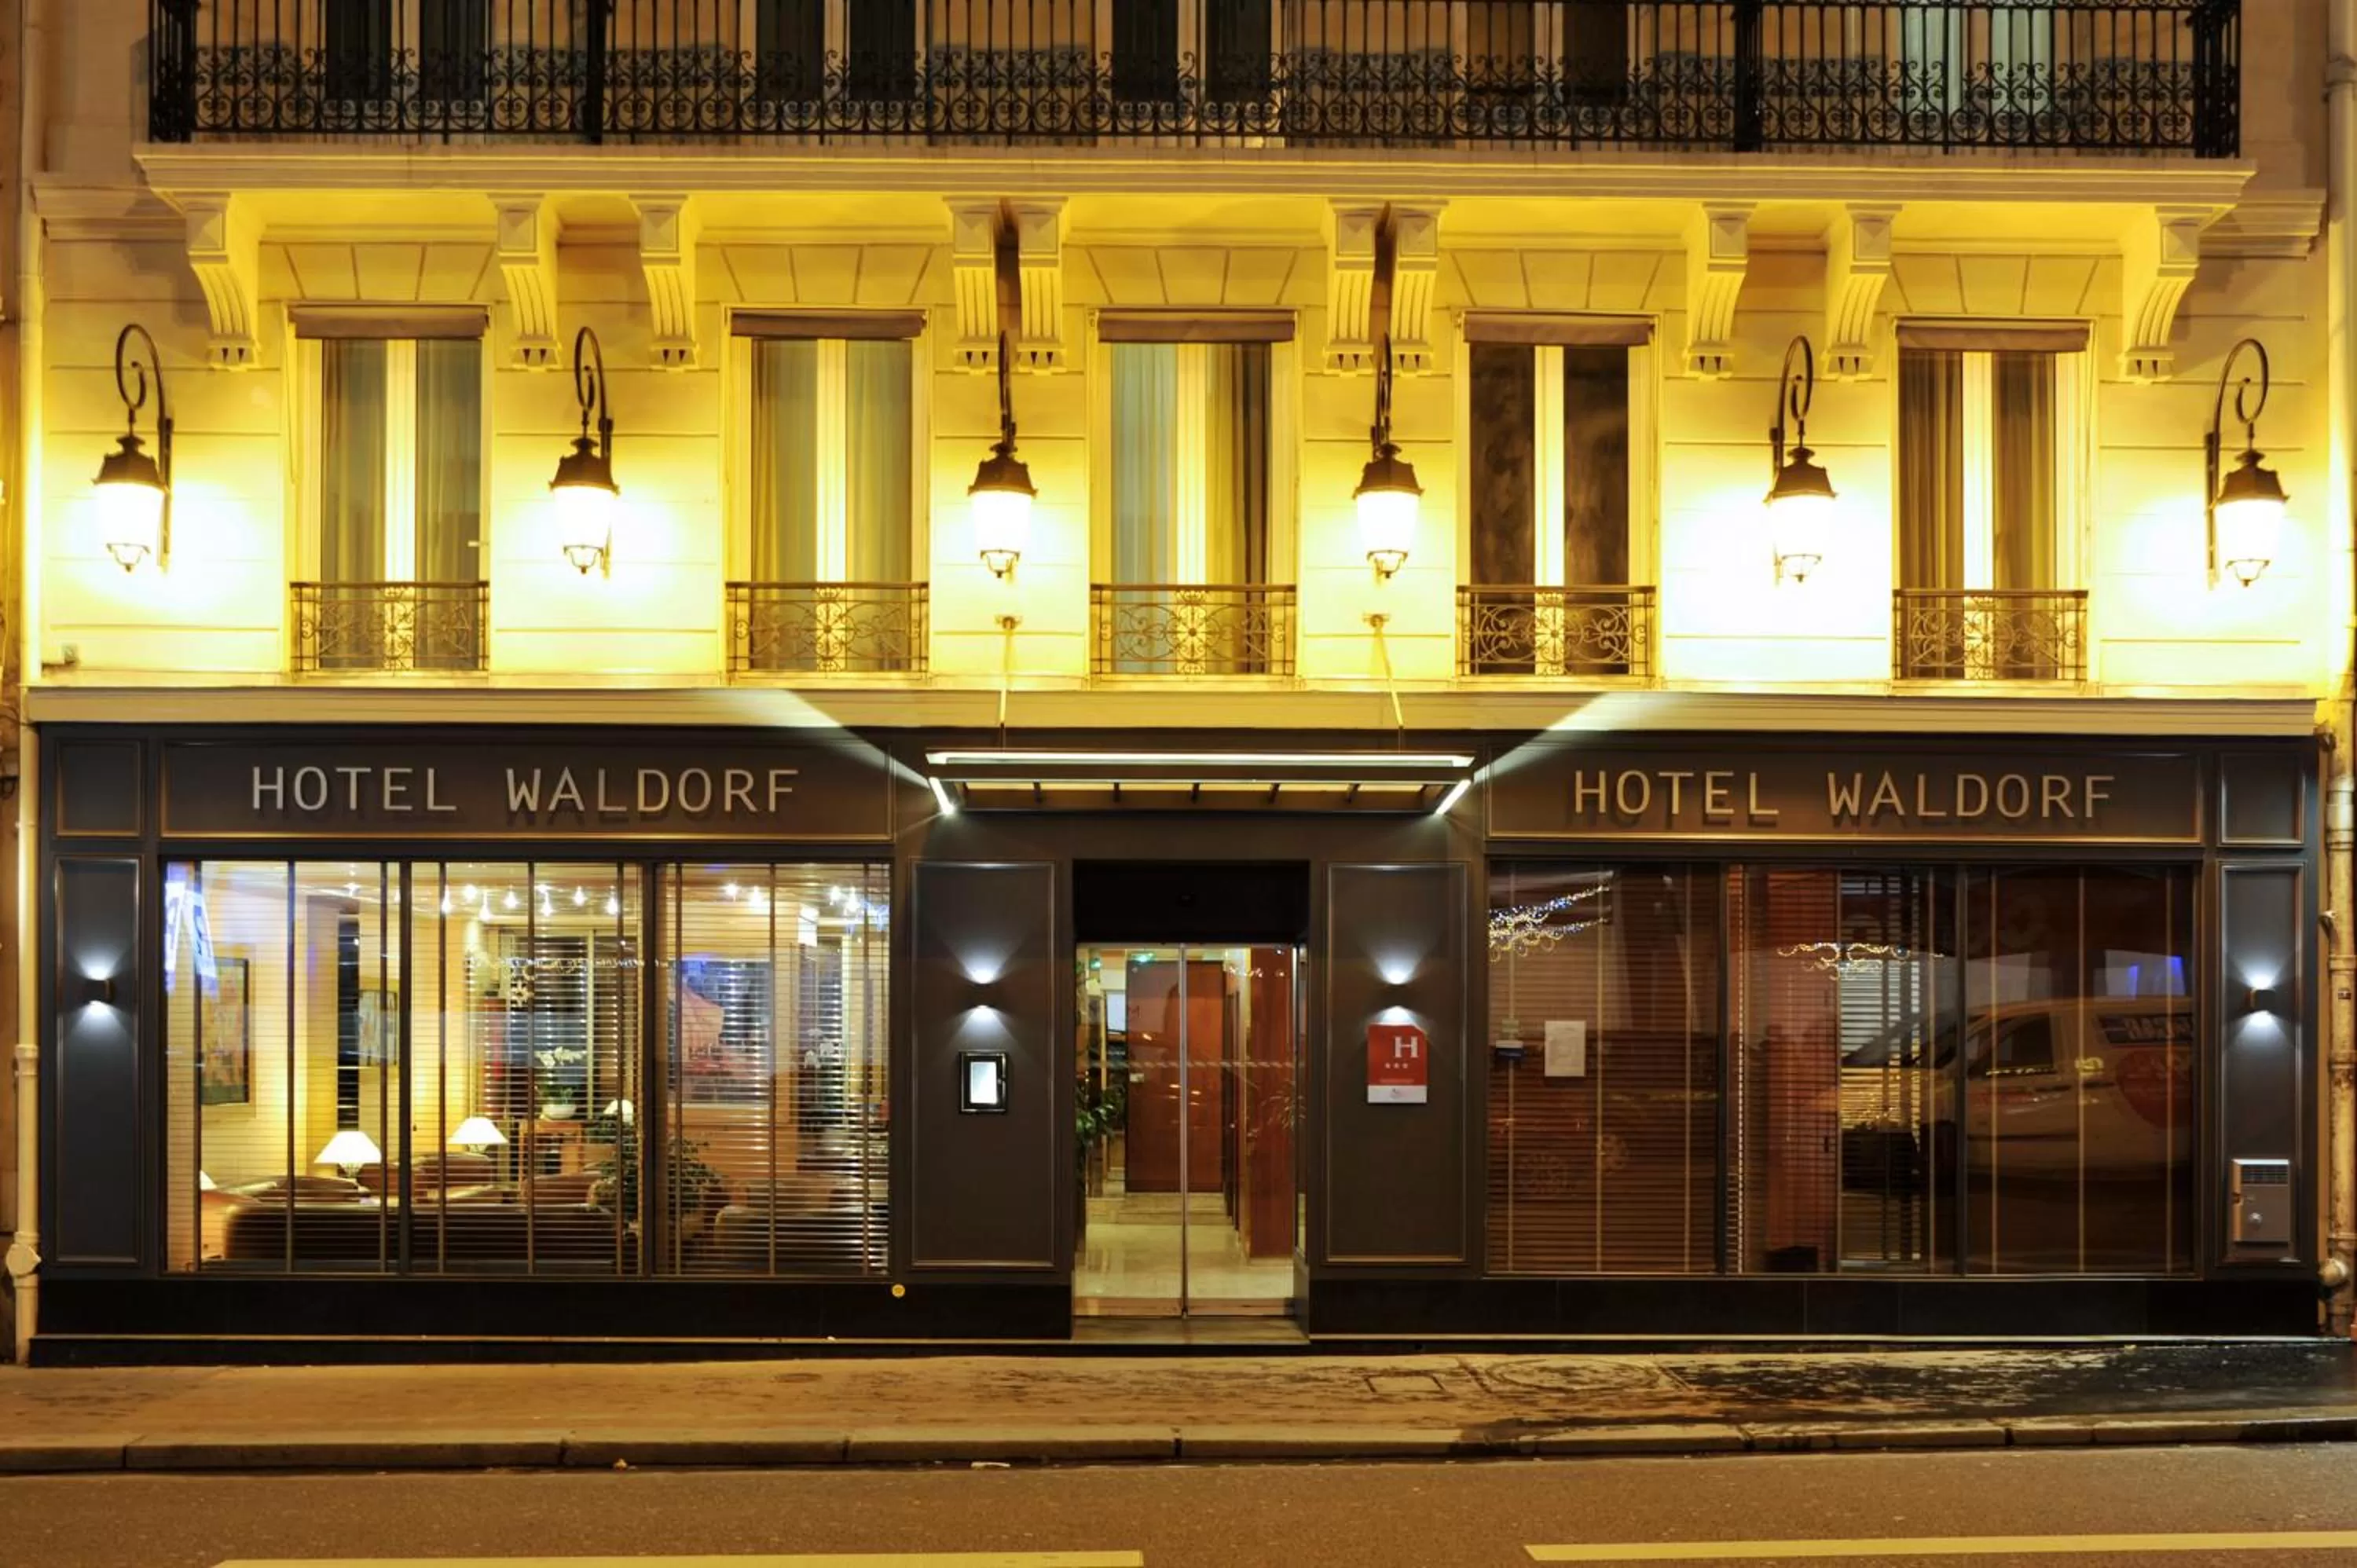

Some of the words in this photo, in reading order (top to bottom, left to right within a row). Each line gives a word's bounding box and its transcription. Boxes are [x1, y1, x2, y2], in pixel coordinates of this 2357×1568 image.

[251, 765, 457, 811] HOTEL
[506, 767, 798, 813] WALDORF
[1574, 770, 1780, 815] HOTEL
[1827, 771, 2116, 819] WALDORF
[1394, 1035, 1420, 1058] H
